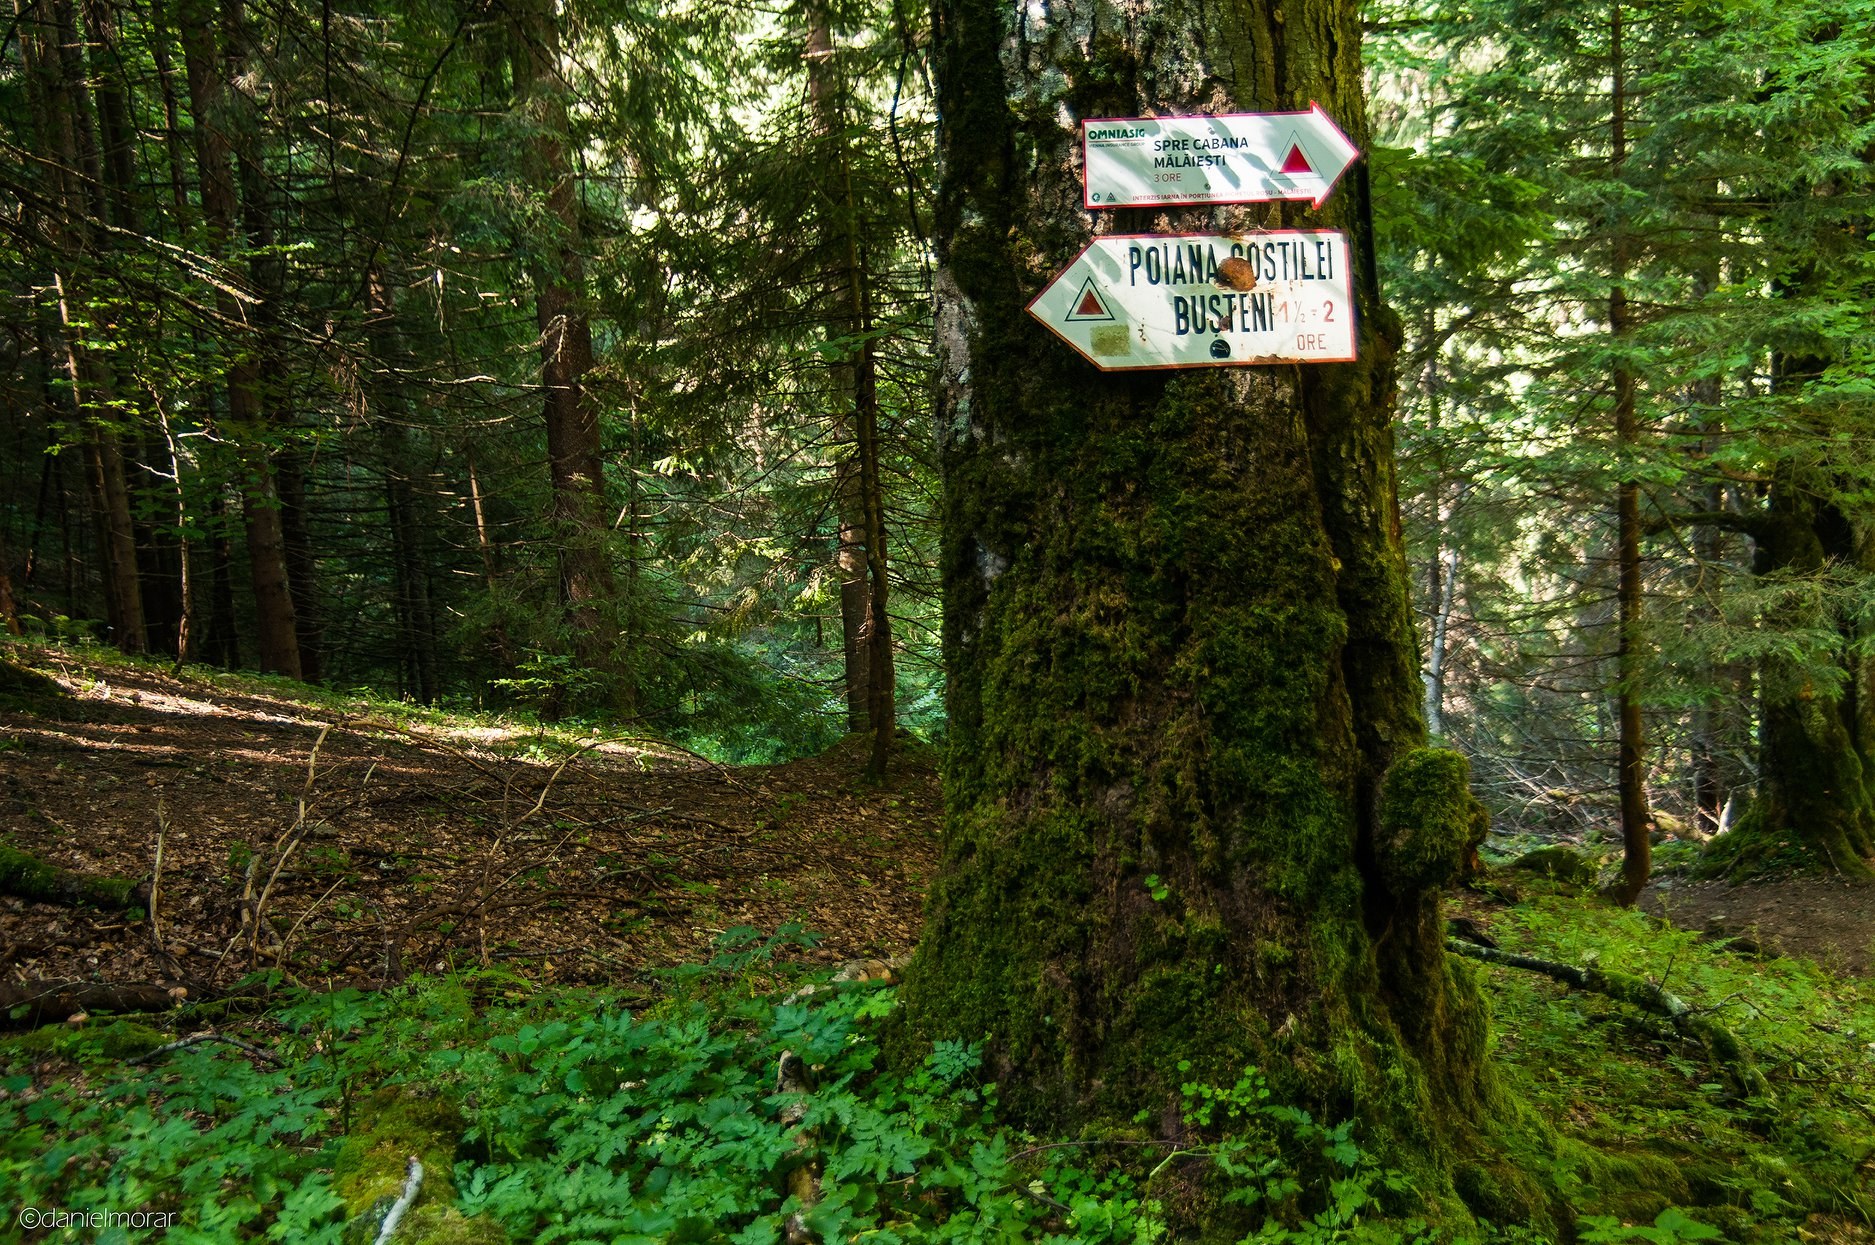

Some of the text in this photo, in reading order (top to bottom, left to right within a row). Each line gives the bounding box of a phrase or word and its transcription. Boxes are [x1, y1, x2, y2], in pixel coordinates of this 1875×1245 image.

[1088, 128, 1145, 140] OMNIASIG
[1154, 137, 1249, 152] SPRE CABANA
[1154, 173, 1182, 183] 3 ORE
[1297, 333, 1327, 351] ORE
